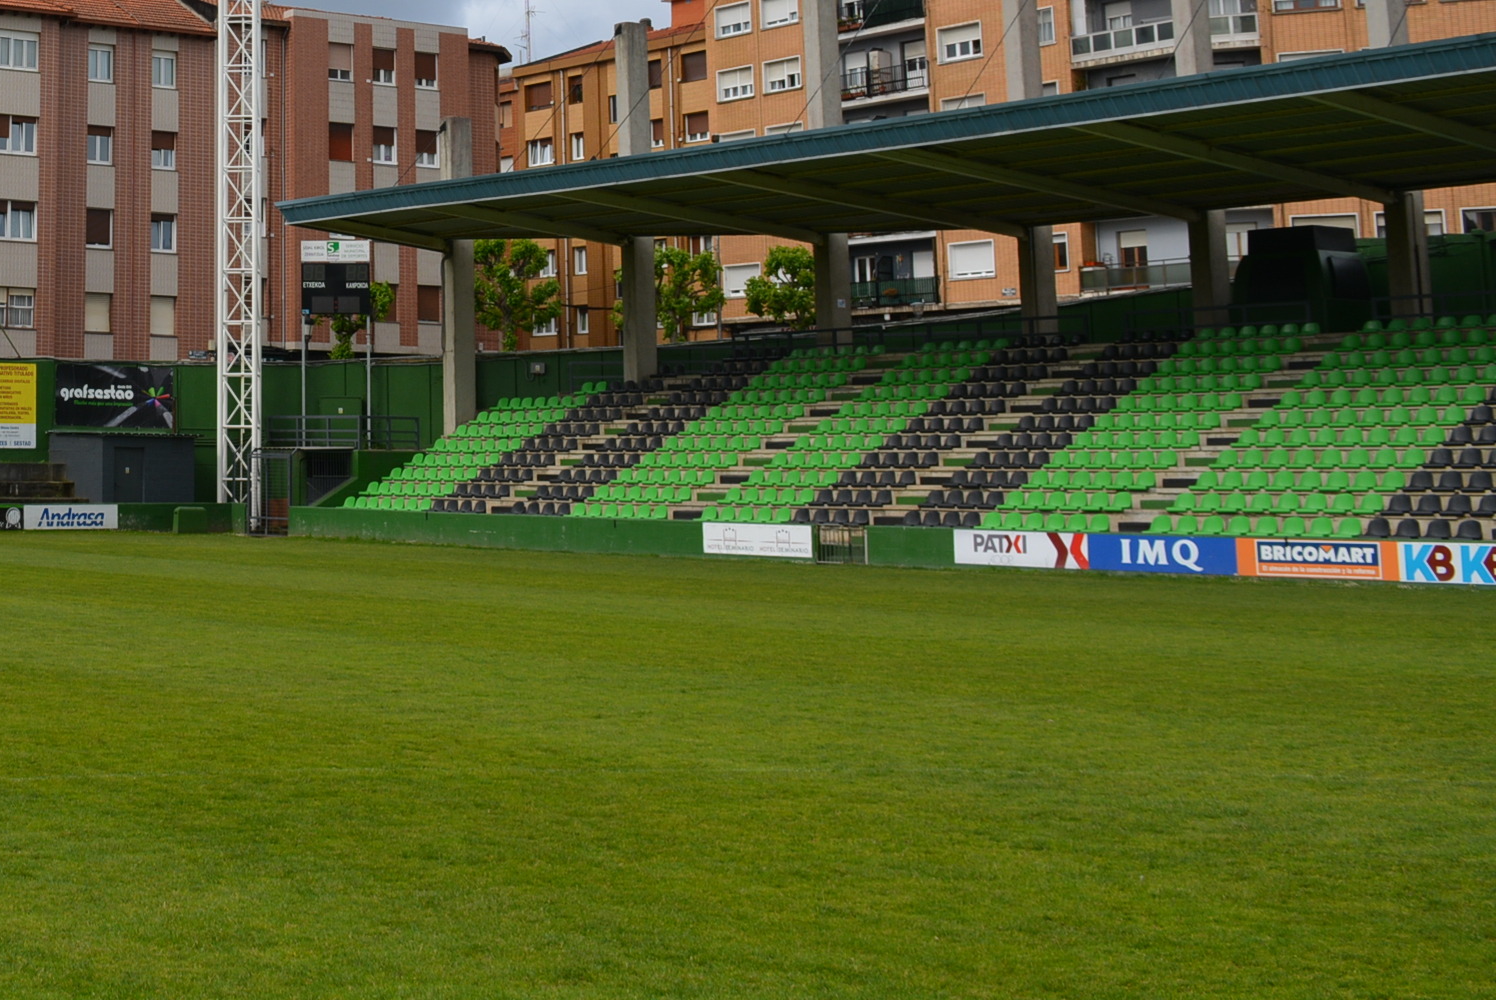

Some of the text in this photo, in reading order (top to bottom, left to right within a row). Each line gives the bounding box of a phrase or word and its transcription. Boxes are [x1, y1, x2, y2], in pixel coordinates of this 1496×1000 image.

[303, 281, 326, 289] ETXEKOA
[38, 508, 105, 527] Andrasa
[973, 533, 1027, 554] PATXI
[1120, 538, 1204, 572] IMQ
[1259, 544, 1375, 564] BRICOMART
